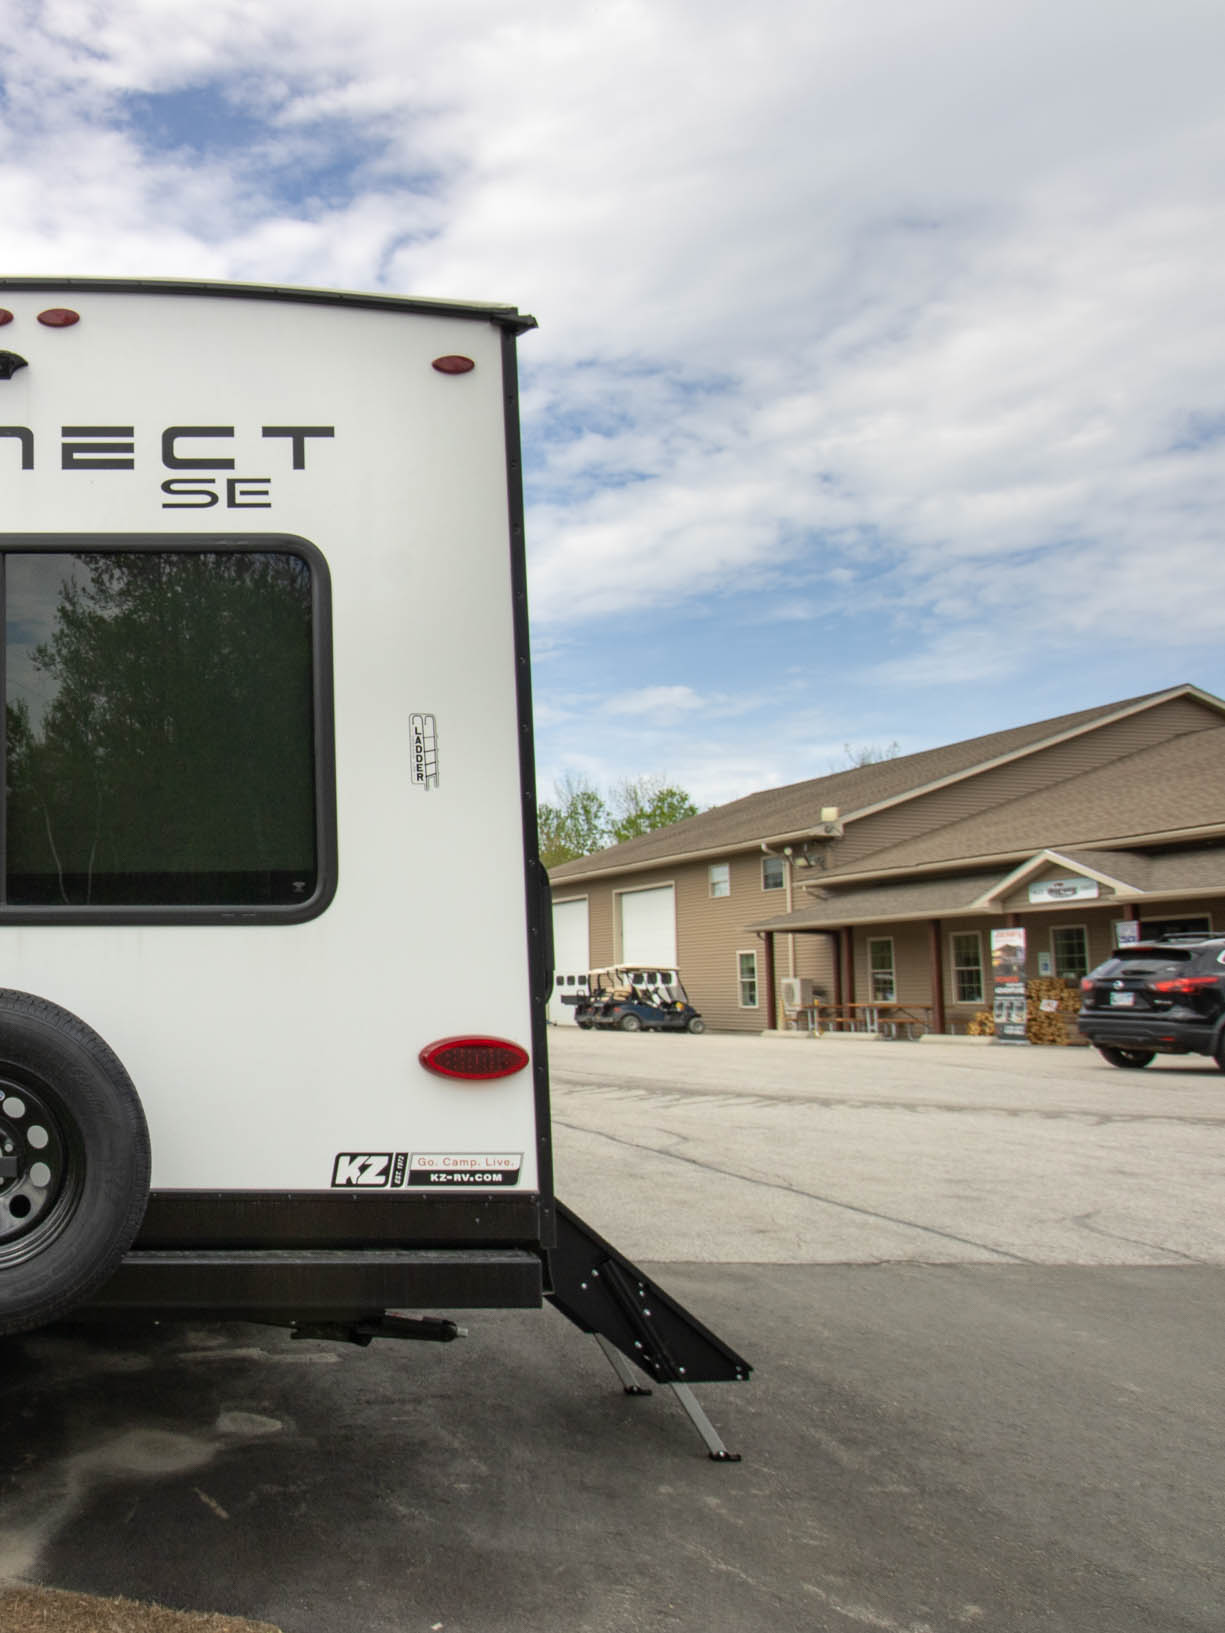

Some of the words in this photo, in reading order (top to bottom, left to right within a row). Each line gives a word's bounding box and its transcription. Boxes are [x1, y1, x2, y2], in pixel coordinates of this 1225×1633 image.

[160, 478, 272, 509] SE
[414, 726, 424, 782] LADDER
[334, 1155, 390, 1185] KZ
[417, 1157, 439, 1167] Go.
[442, 1157, 481, 1169] Camp.
[485, 1157, 515, 1168] Live.
[429, 1173, 503, 1182] KZ-RV.COM
